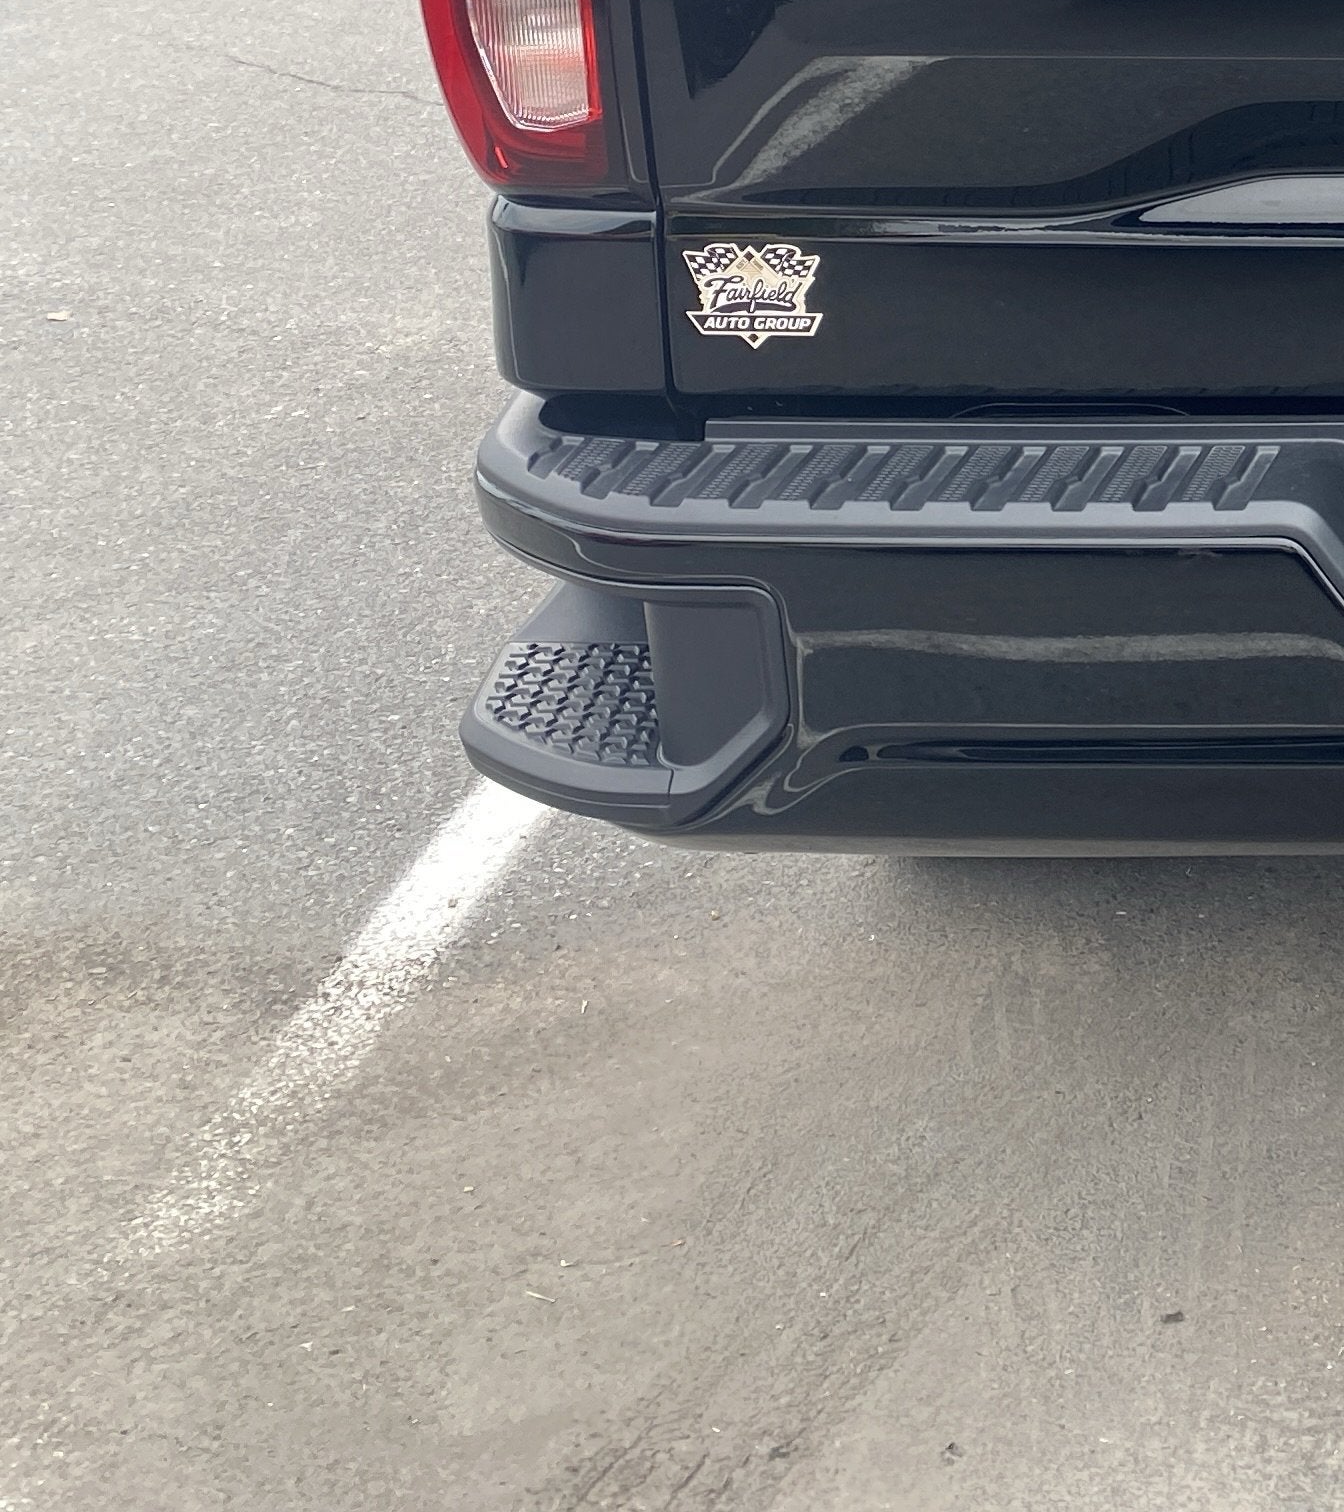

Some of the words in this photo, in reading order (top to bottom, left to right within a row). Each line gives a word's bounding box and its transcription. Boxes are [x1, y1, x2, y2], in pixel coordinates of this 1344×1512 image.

[704, 275, 803, 313] Fairfield
[704, 317, 749, 329] AUTO
[754, 317, 811, 330] GROUP
